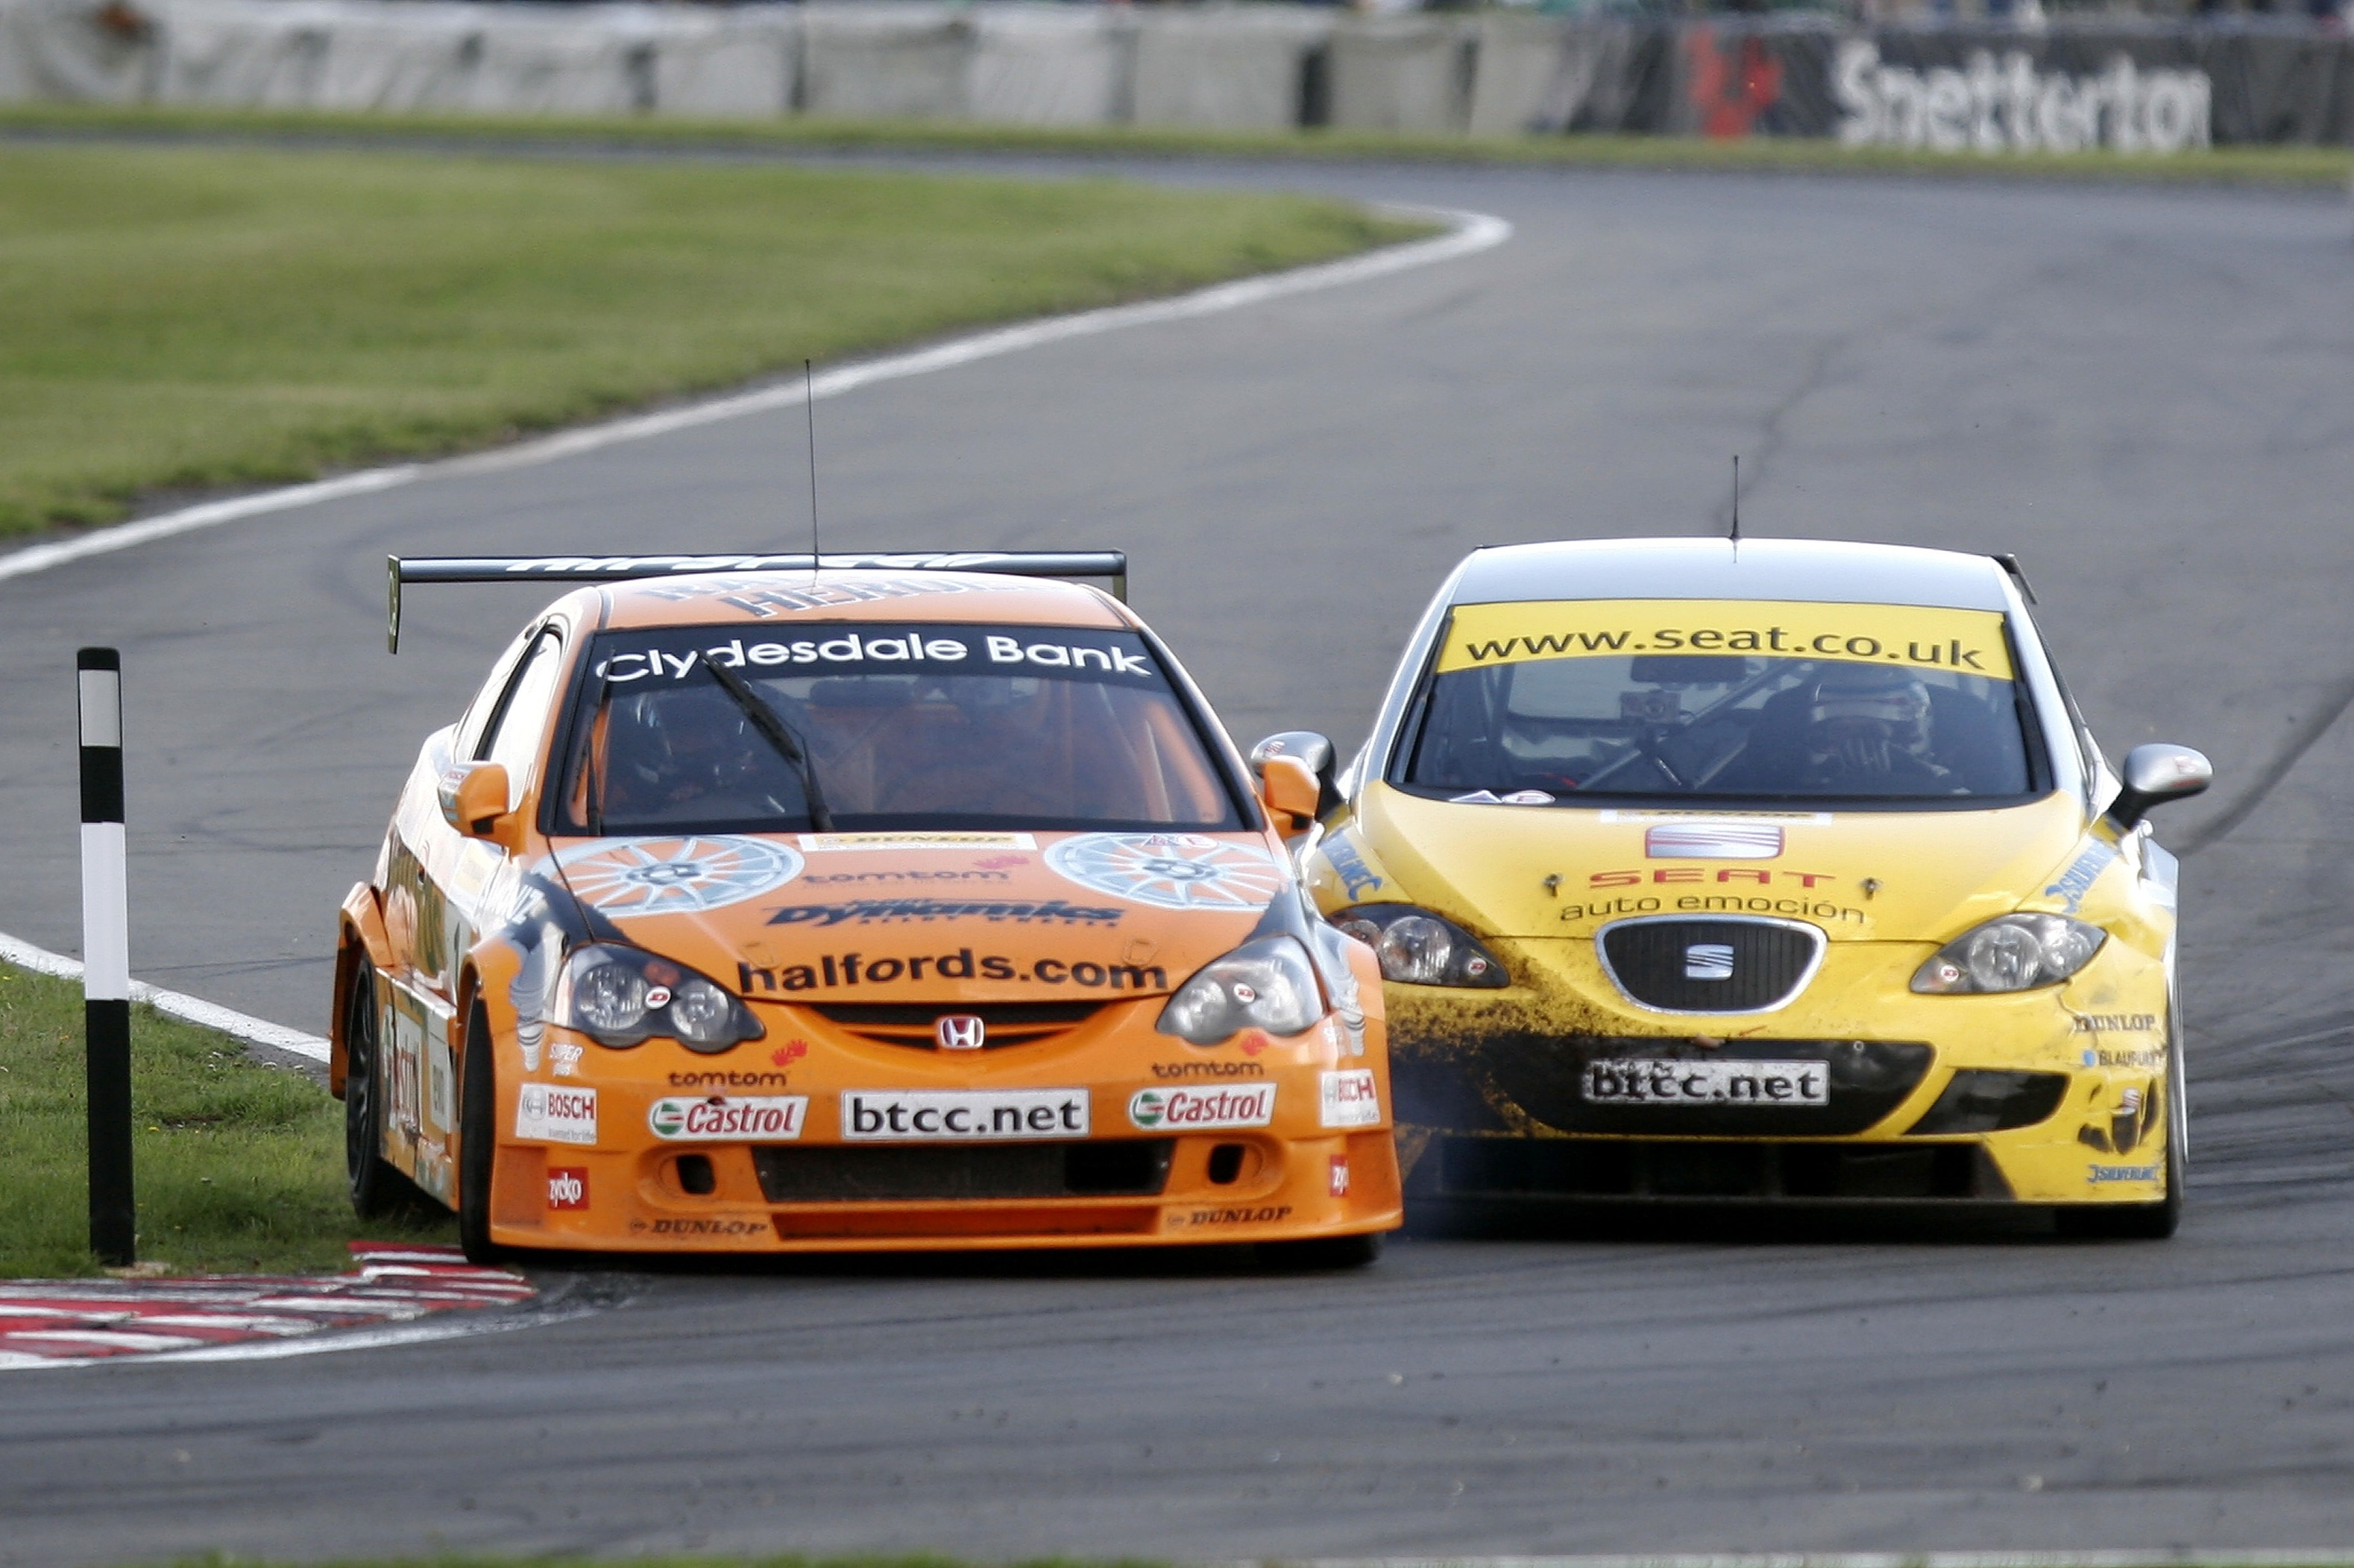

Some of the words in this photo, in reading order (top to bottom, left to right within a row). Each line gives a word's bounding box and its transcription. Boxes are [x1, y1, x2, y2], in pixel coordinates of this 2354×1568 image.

[595, 633, 969, 681] Clydesdale
[986, 635, 1153, 675] Bank
[1467, 626, 1985, 669] www.seat.co.uk
[1590, 869, 1836, 888] SEAT
[1560, 896, 1660, 921] auto
[1677, 893, 1864, 923] emoción
[737, 948, 1168, 995] halfords.com
[670, 1071, 788, 1086] tomtom
[1151, 1062, 1264, 1078] tomtom
[1593, 1060, 1821, 1099] btcc.net
[547, 1092, 596, 1119] BOSCH
[687, 1104, 796, 1134] Castrol
[852, 1098, 1083, 1133] btcc.net
[1167, 1091, 1268, 1122] Castrol
[650, 1218, 768, 1235] DUNLOP
[1189, 1206, 1293, 1226] DUNLOP
